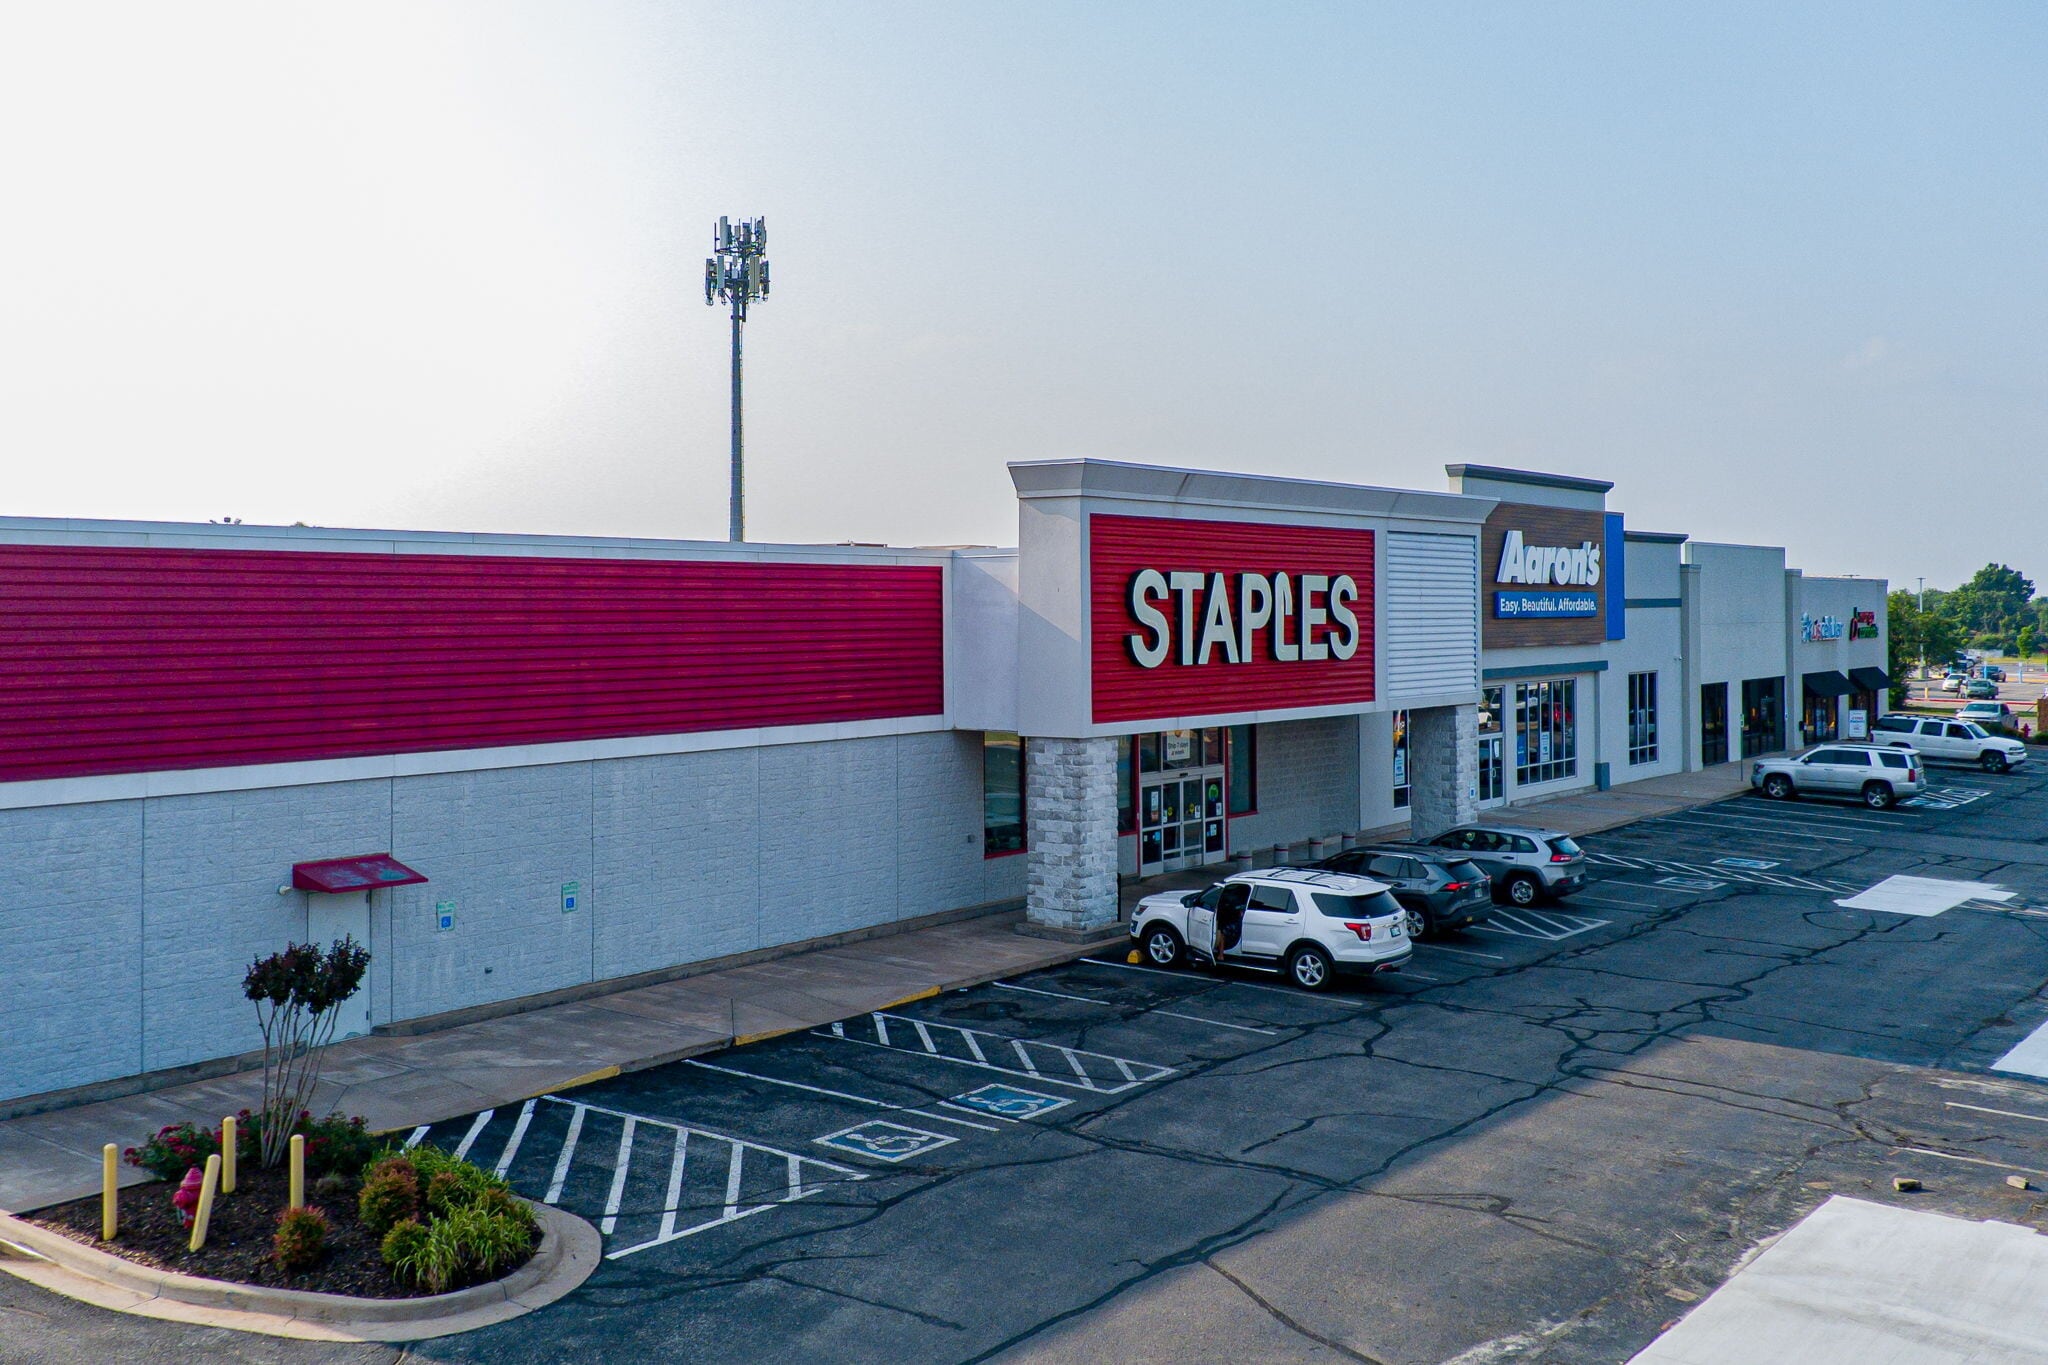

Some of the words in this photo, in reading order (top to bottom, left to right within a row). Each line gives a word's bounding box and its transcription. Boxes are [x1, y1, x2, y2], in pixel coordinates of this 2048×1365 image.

[1497, 530, 1600, 586] Aaron's
[1130, 568, 1360, 669] STAPLES
[1500, 598, 1520, 614] Easy.
[1521, 597, 1557, 612] Beautiful.
[1558, 598, 1597, 612] Affordable.
